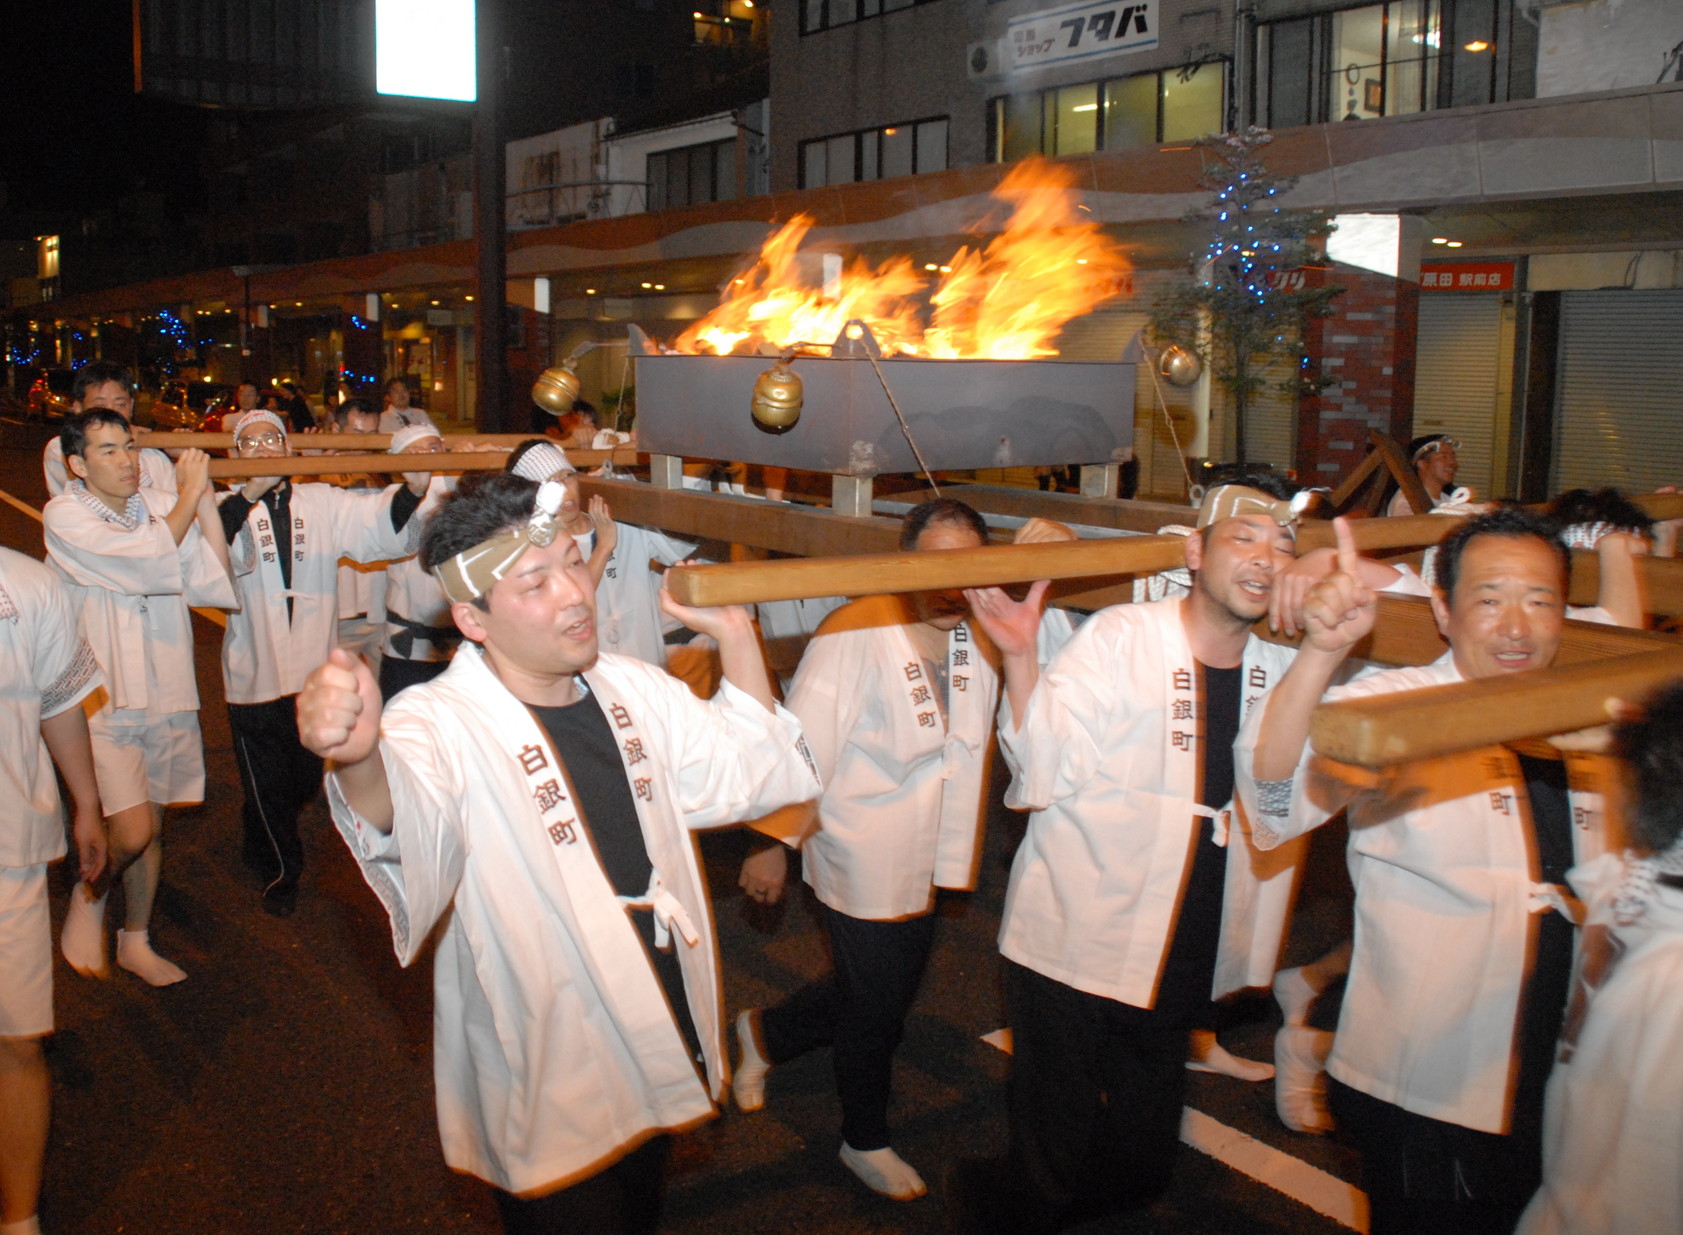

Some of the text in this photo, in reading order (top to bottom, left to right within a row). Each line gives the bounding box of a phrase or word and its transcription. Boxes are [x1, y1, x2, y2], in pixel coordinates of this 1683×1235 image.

[1017, 38, 1056, 58] ショップ
[1060, 4, 1148, 48] フタバ
[1420, 272, 1454, 287] 原田
[257, 518, 276, 563] 白銀町
[294, 517, 306, 562] 白銀町
[951, 623, 971, 692] 白銀町
[903, 661, 938, 728] 白銀町
[1171, 667, 1195, 752] 白銀町
[609, 702, 653, 802] 白銀町
[517, 744, 578, 846] 白銀町
